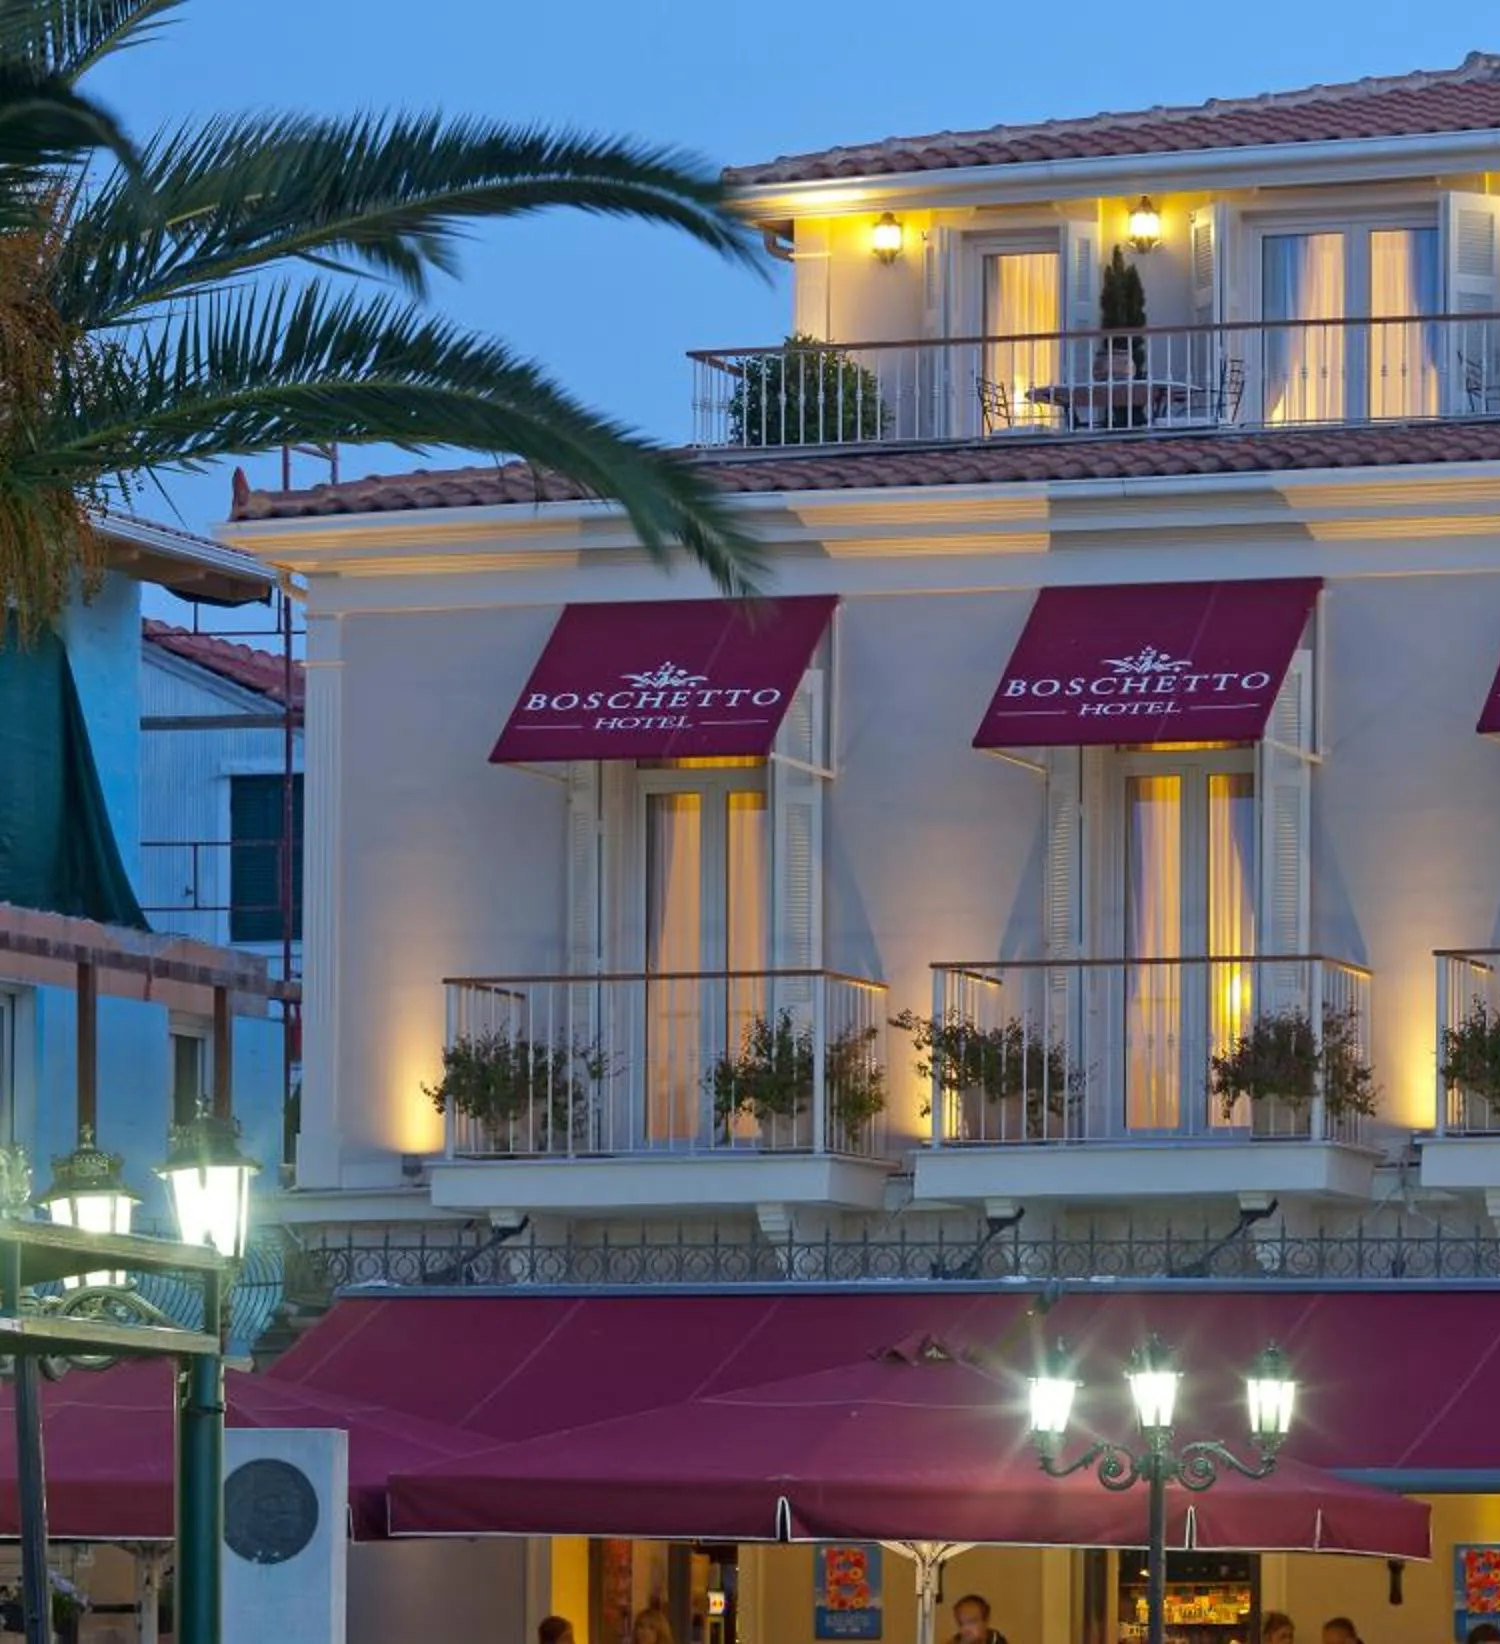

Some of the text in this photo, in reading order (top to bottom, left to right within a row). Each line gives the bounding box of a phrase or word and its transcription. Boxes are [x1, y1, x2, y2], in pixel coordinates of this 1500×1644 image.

[1003, 671, 1271, 697] BOSCHETTO
[523, 688, 782, 711] BOSCHETTO
[1077, 701, 1182, 717] HOTEL
[592, 715, 694, 730] HOTEL
